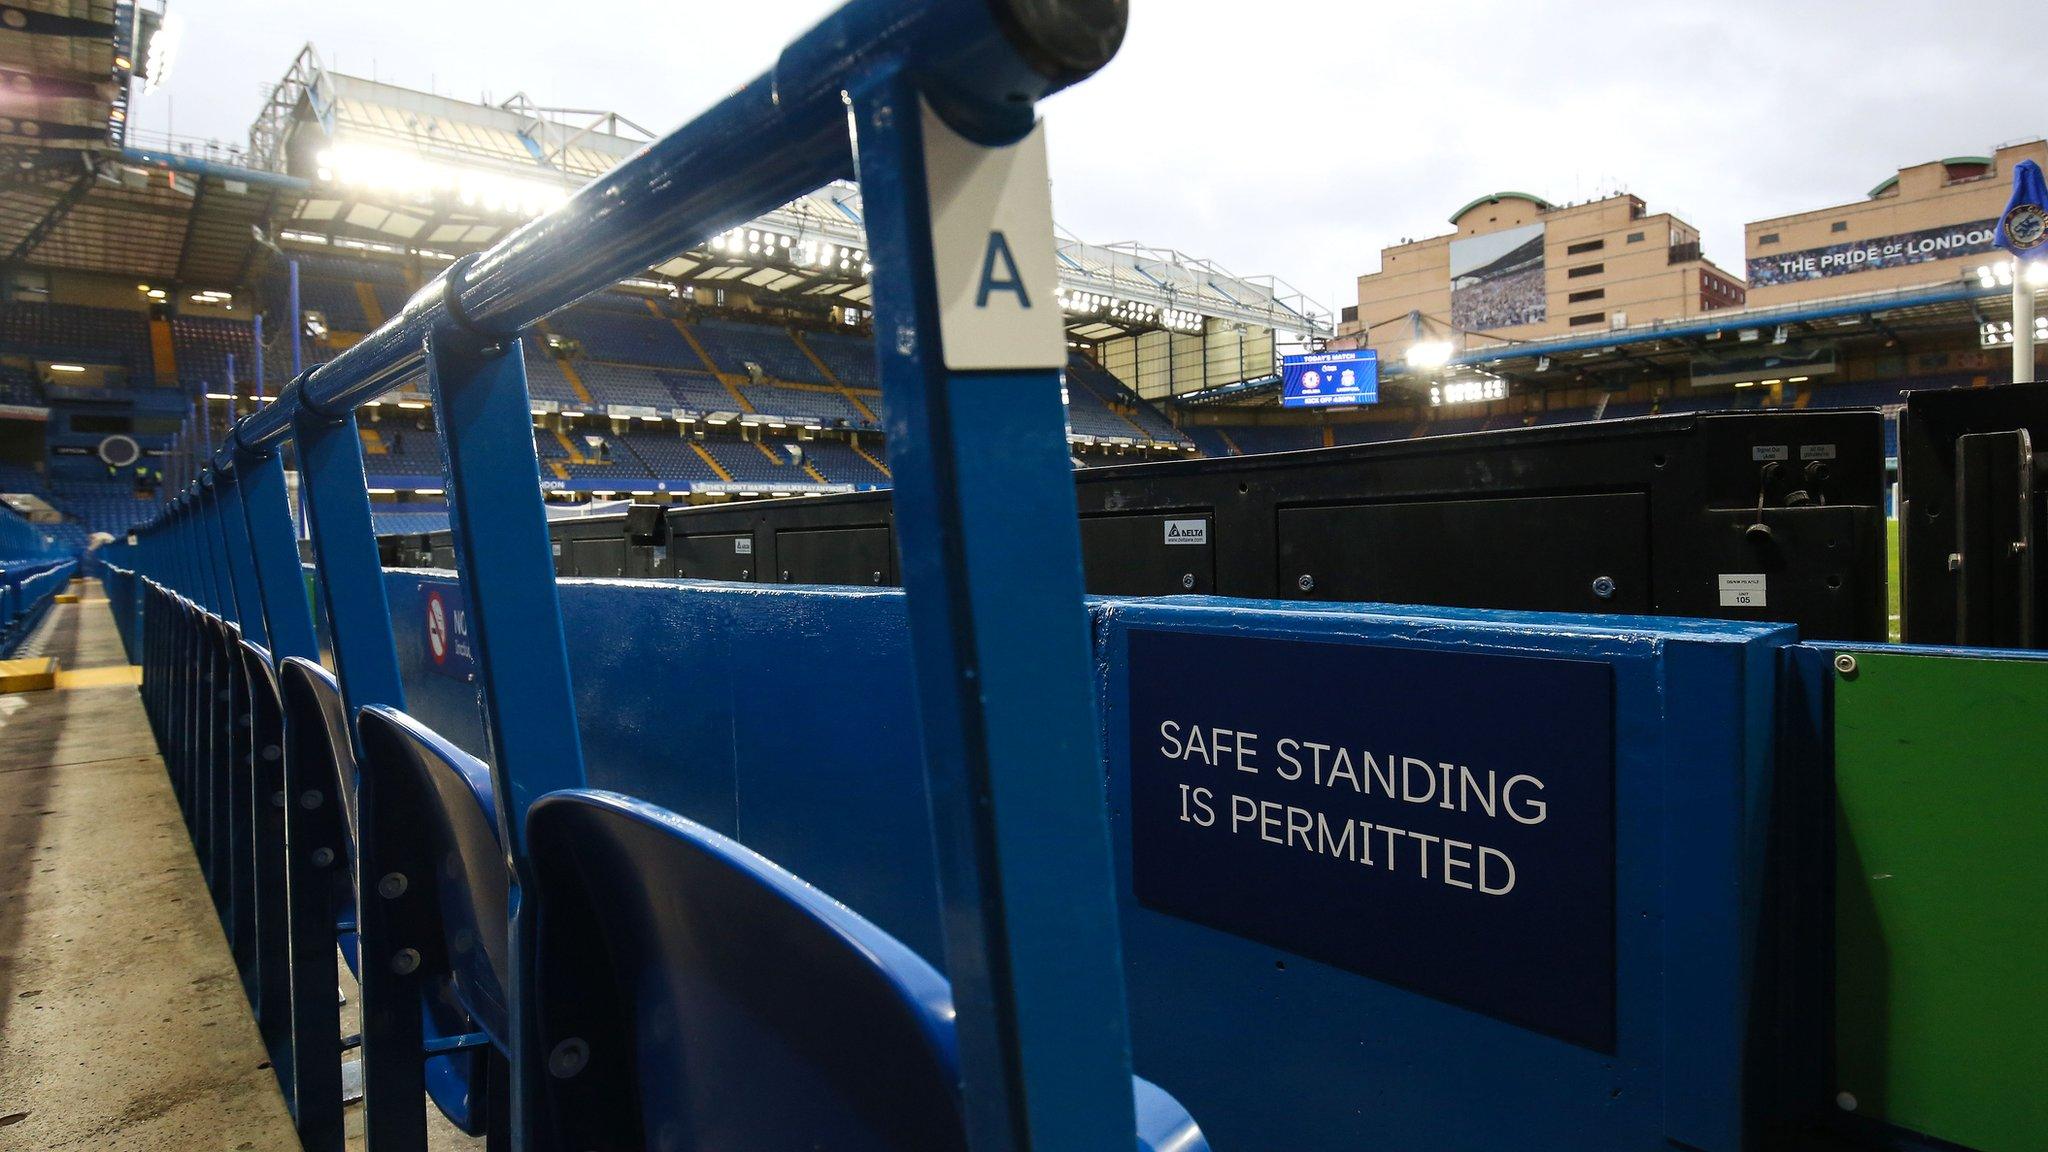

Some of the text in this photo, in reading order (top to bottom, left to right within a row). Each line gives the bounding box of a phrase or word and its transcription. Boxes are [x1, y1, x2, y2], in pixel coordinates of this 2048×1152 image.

[975, 230, 1032, 308] A
[1780, 257, 1815, 274] THE
[1820, 247, 1878, 269] PRIDE
[1883, 243, 1902, 255] OF
[454, 610, 467, 636] NO
[1736, 596, 1750, 604] 105
[1160, 719, 1548, 825] SAFE STANDING
[1179, 783, 1517, 897] IS PERMITTED
